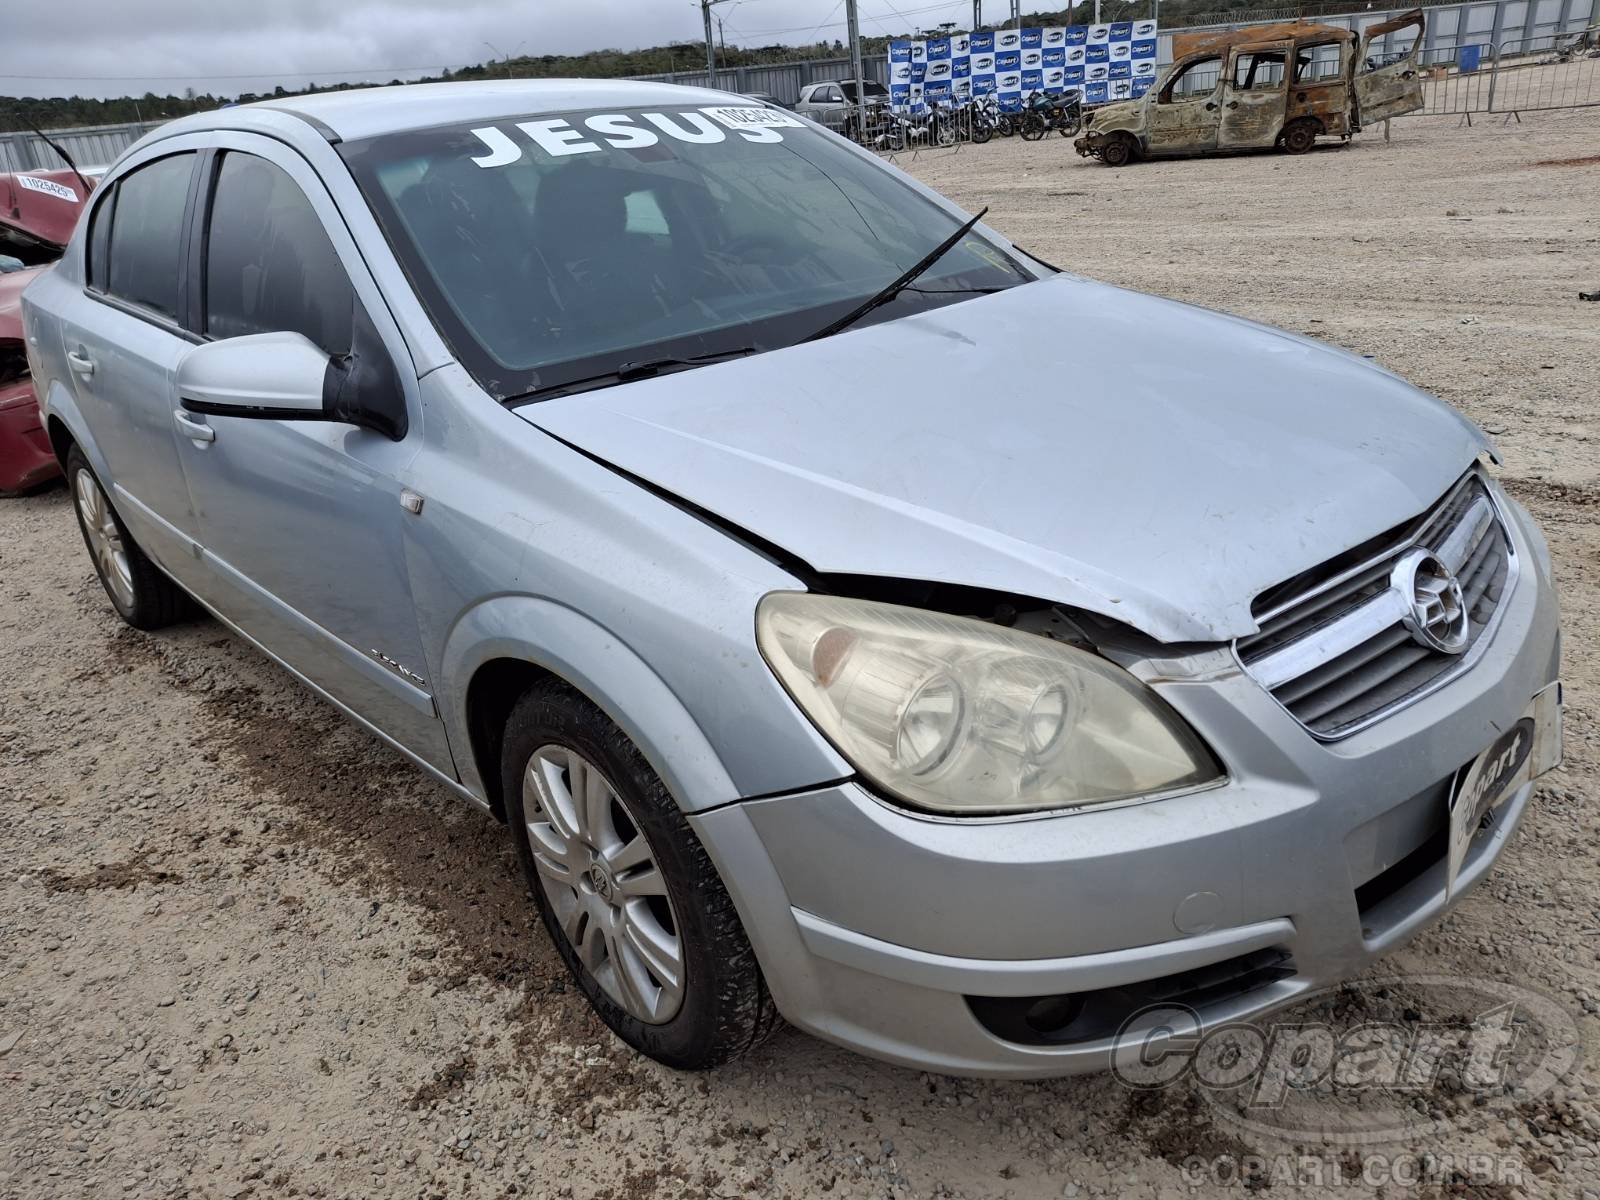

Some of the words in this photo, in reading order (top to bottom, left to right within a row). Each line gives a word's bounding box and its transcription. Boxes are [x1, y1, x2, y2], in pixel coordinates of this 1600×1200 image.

[1067, 32, 1084, 40] Copart
[1043, 54, 1062, 62] Copart
[27, 178, 68, 196] 1025425
